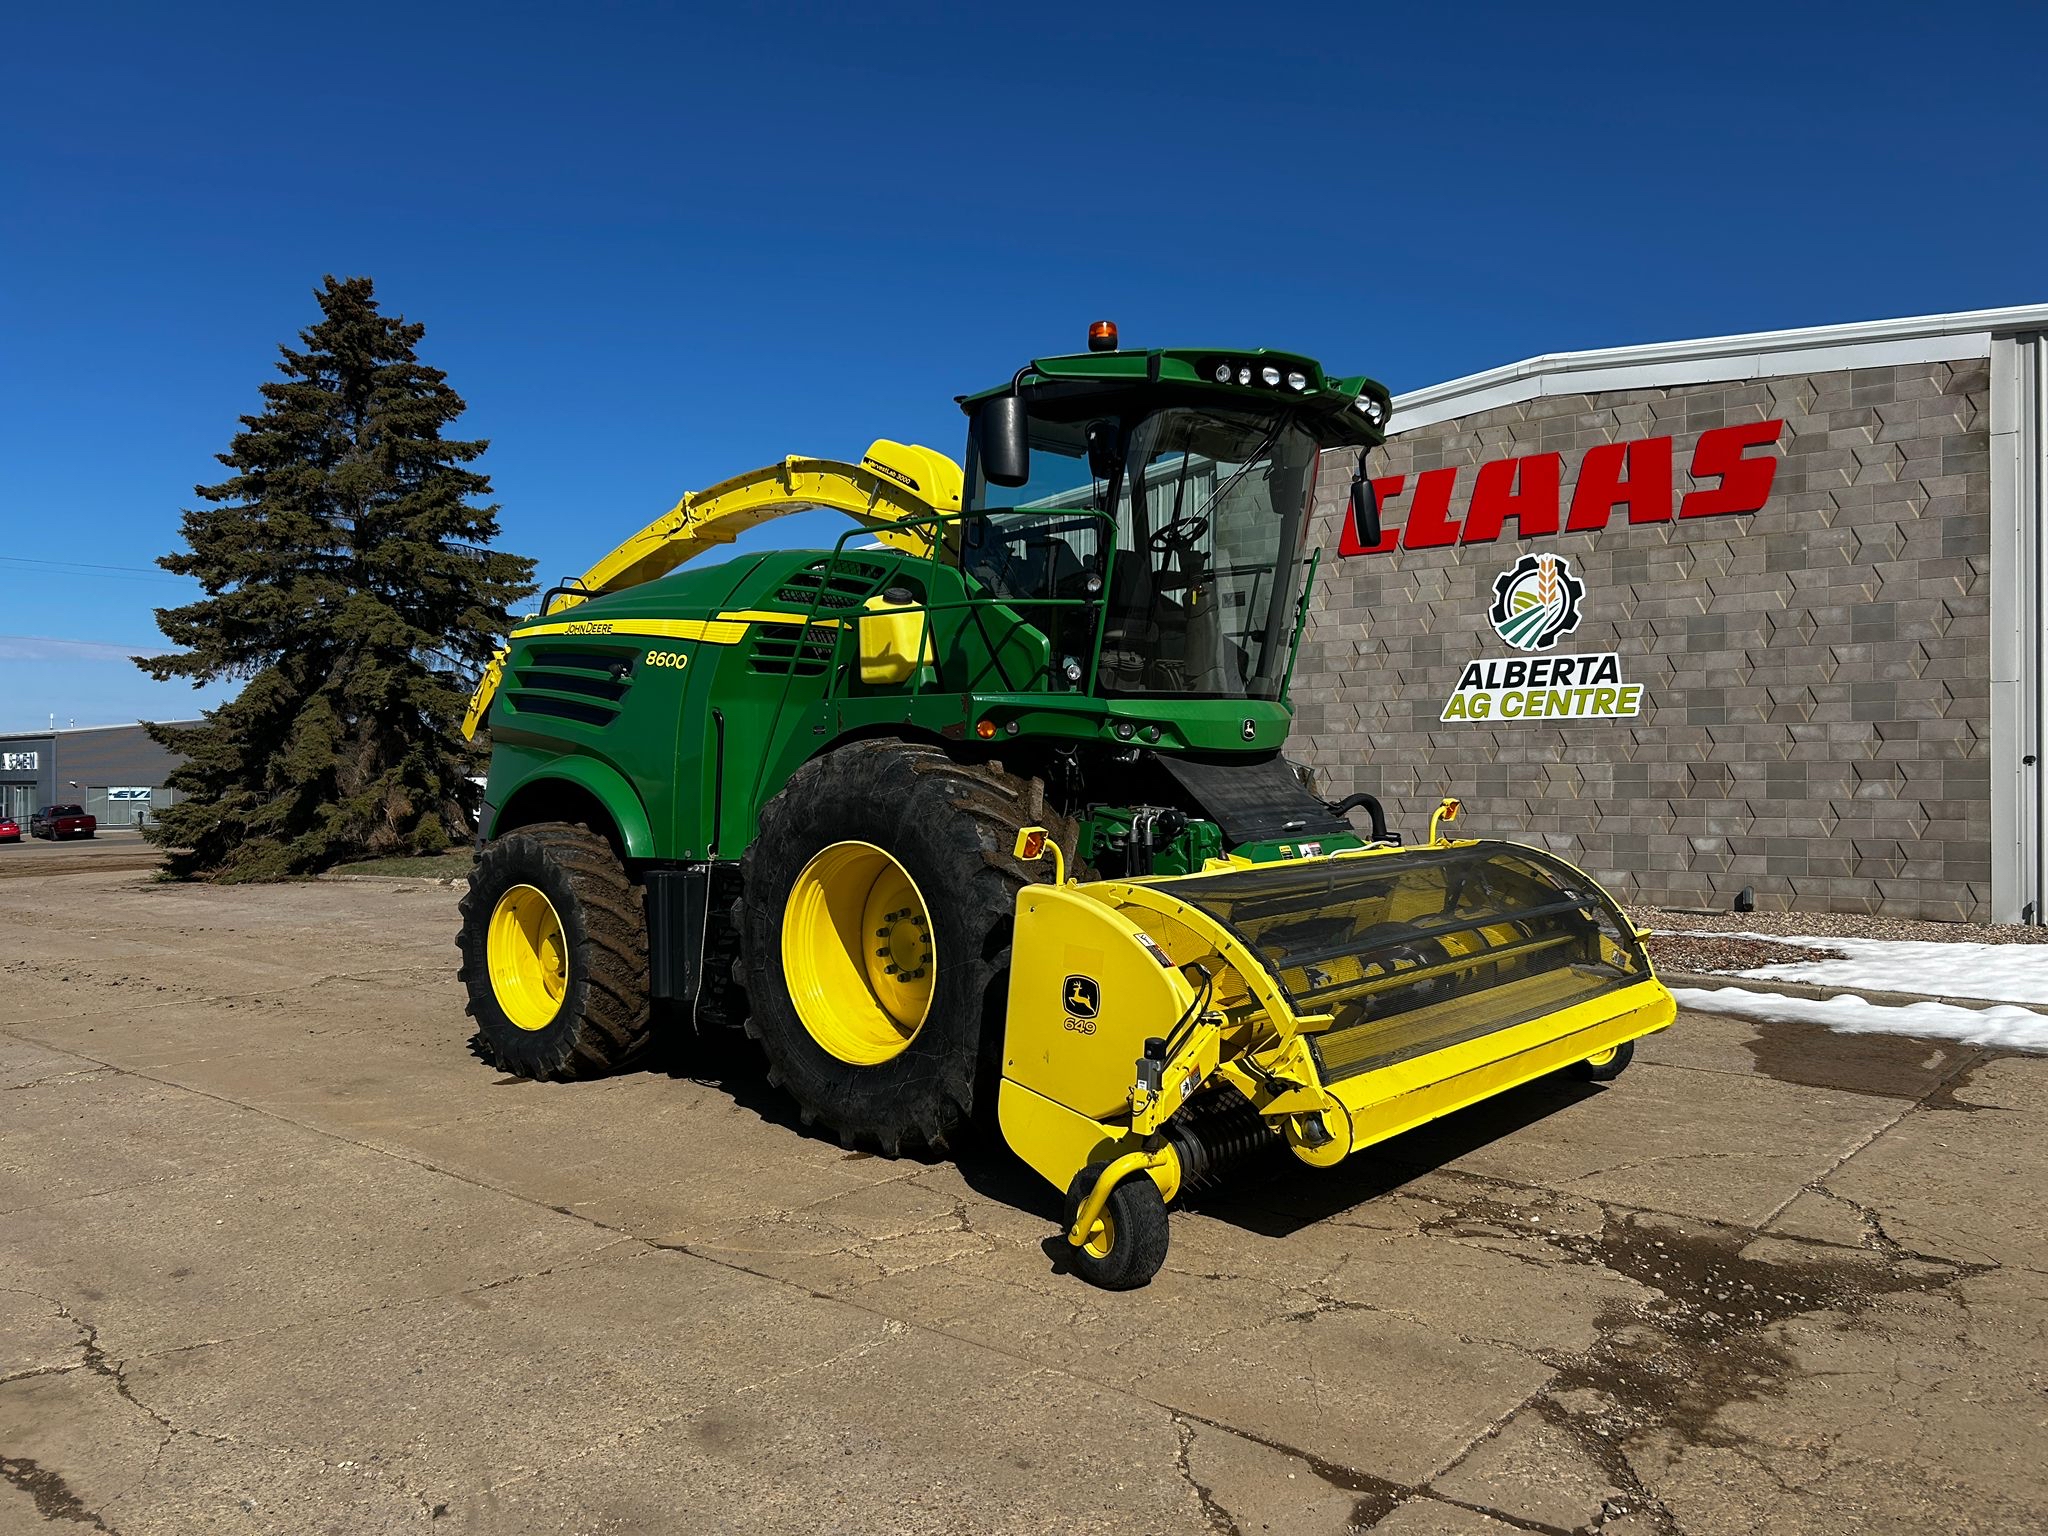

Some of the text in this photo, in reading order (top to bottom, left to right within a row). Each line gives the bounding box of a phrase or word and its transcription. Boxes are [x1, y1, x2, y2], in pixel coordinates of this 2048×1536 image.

[896, 473, 911, 485] 3000
[1339, 419, 1783, 557] CLAAS
[564, 622, 613, 635] JOHN DEERE
[645, 650, 688, 670] 8600
[1458, 656, 1619, 691] ALBERTA
[1443, 687, 1641, 720] AG CENTRE
[1063, 1017, 1097, 1036] 649
